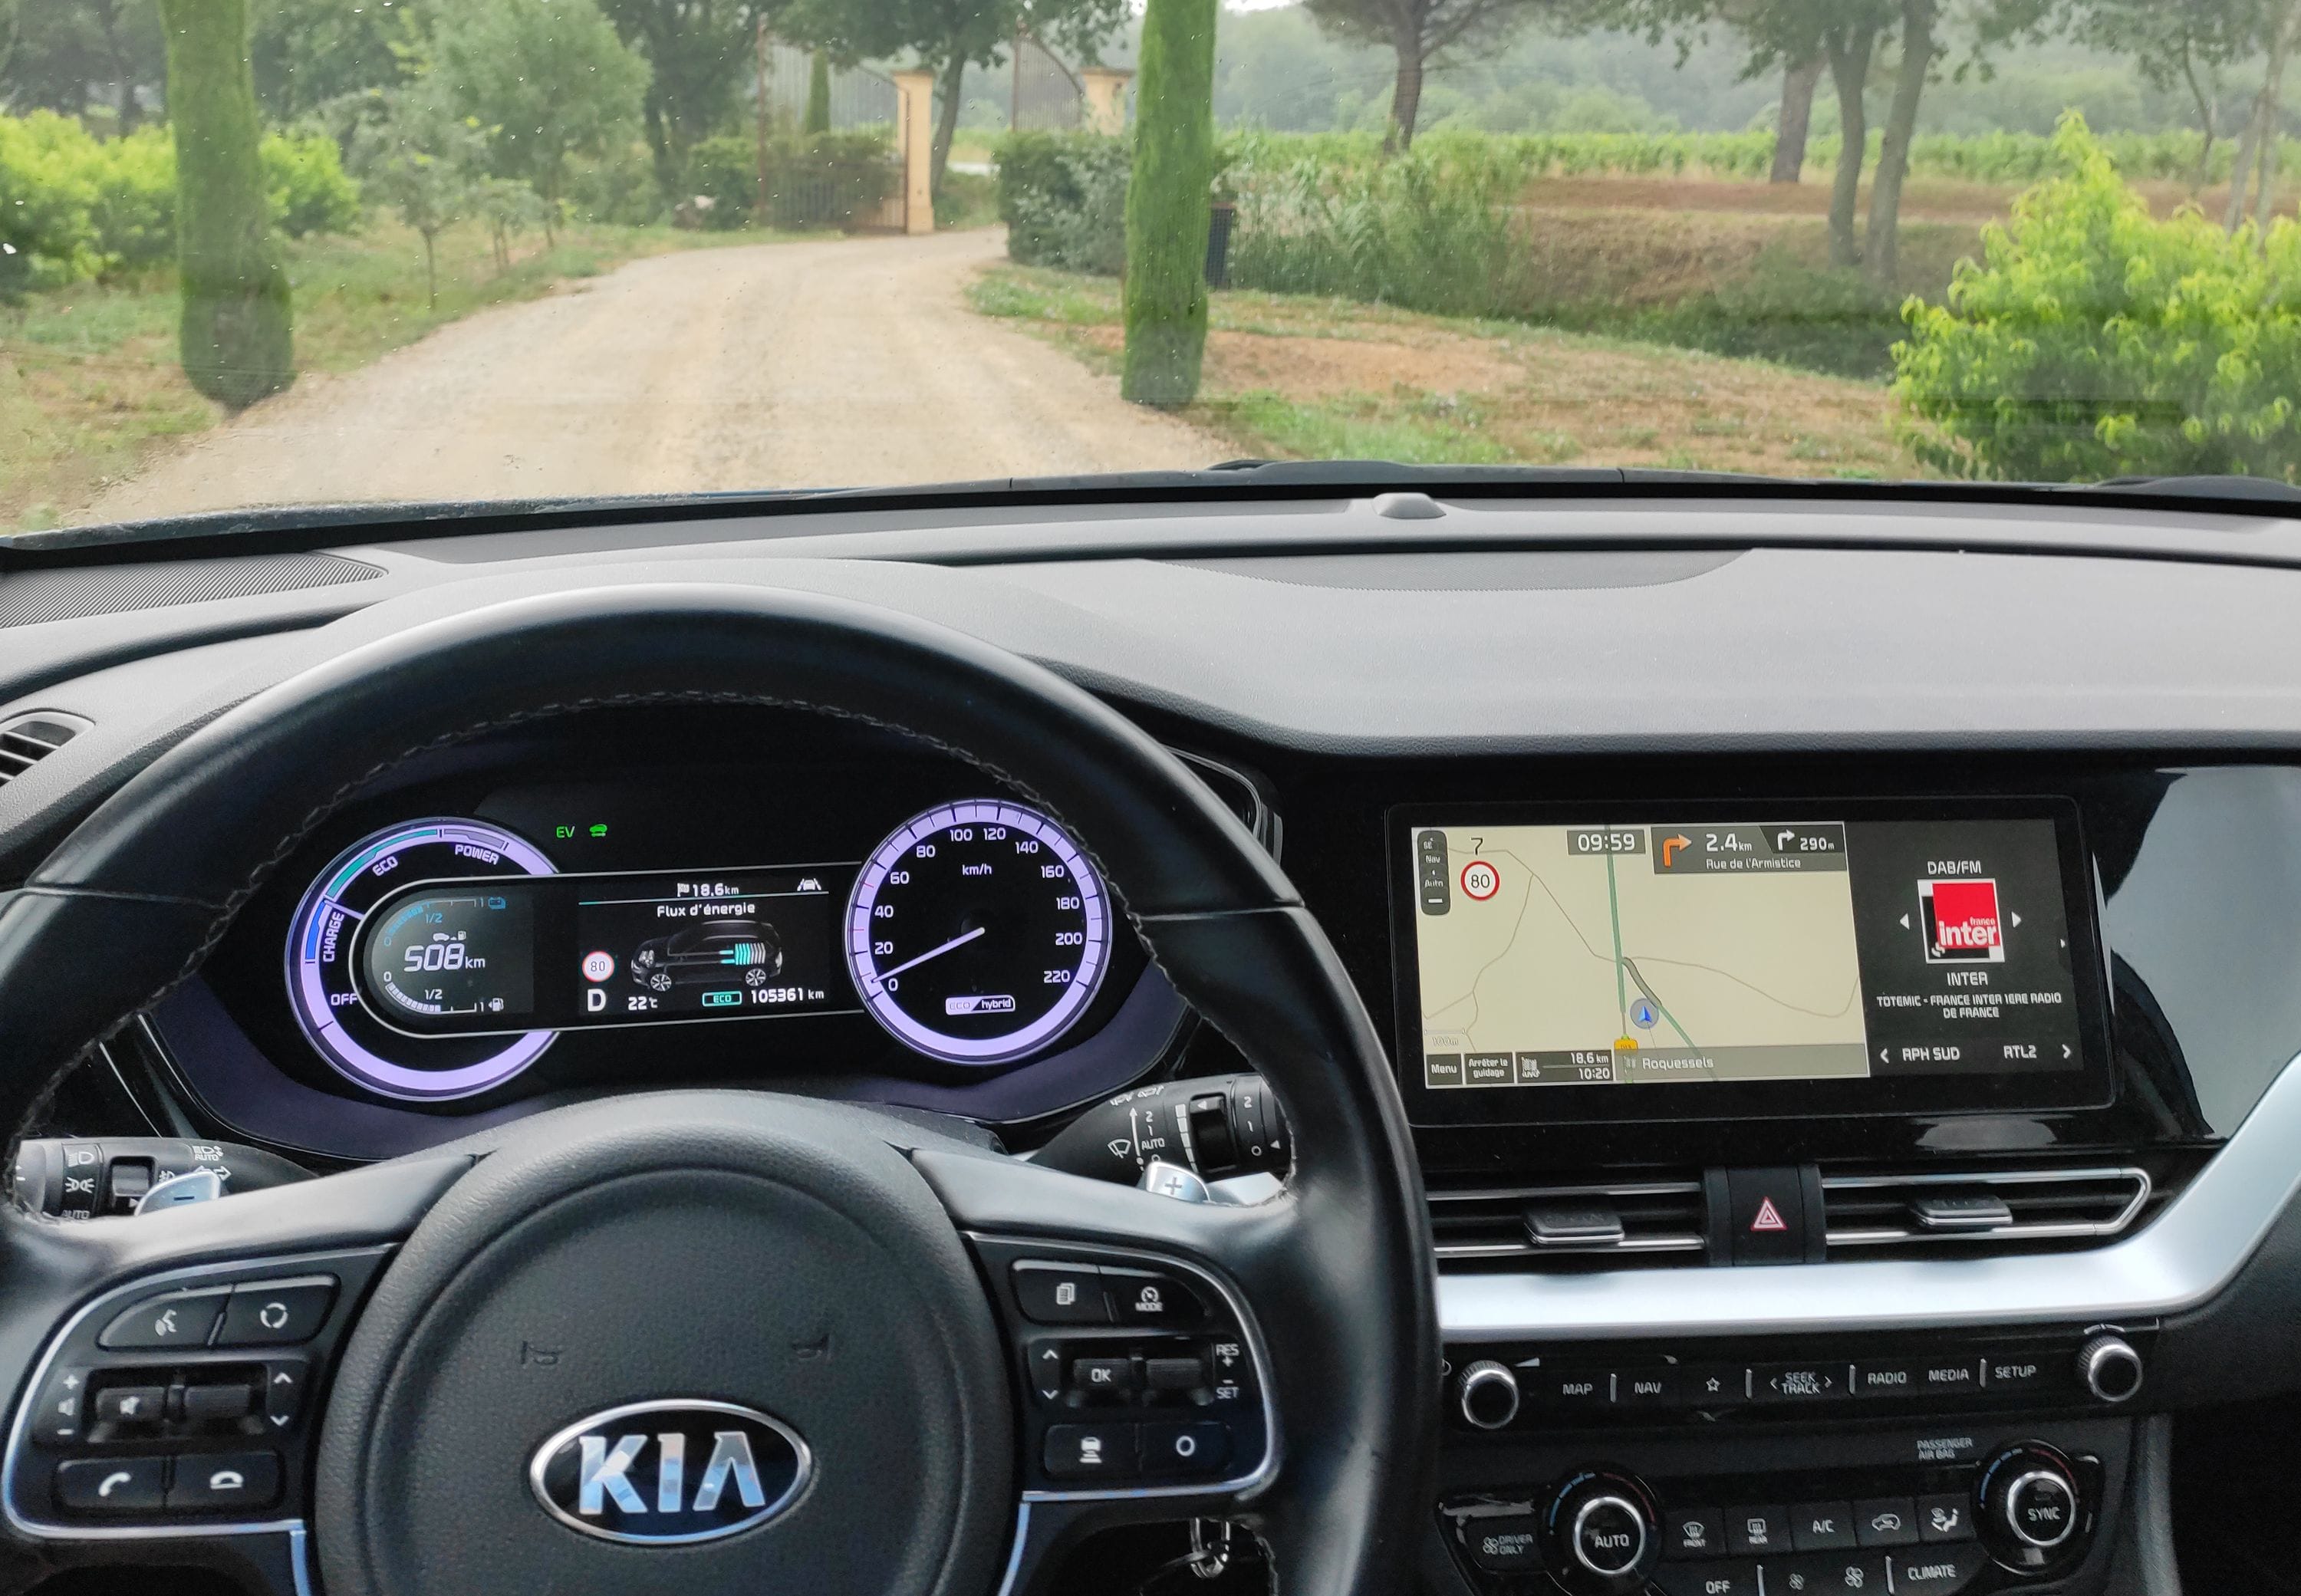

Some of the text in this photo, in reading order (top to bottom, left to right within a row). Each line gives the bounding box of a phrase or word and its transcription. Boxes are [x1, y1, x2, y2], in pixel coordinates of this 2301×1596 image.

[556, 826, 575, 837] EV
[950, 829, 973, 841] 100
[983, 828, 1006, 841] 120
[1015, 841, 1039, 854] 140
[1577, 833, 1636, 852] 09:59
[455, 844, 499, 864] POWER
[916, 845, 936, 858] 80
[372, 856, 399, 877] ECO
[962, 864, 992, 876] km/h
[1706, 859, 1727, 870] Rue
[1730, 858, 1743, 869] de
[1927, 860, 1982, 875] DAB/FM
[890, 871, 910, 884] 60
[1041, 865, 1064, 878] 160
[1470, 874, 1490, 889] 80
[1056, 897, 1080, 910] 180
[657, 904, 686, 917] Flux
[874, 905, 894, 918] 40
[426, 913, 443, 923] 1/2
[323, 911, 344, 963] CHARGE
[1055, 933, 1082, 946] 200
[1937, 921, 1998, 946] inter
[874, 942, 894, 955] 20
[591, 961, 606, 972] 80
[1043, 970, 1071, 983] 220
[1947, 972, 1988, 986] INTER
[888, 978, 898, 992] 0
[331, 993, 357, 1006] OFF
[425, 989, 443, 1000] 1/2
[587, 989, 607, 1012] D
[713, 994, 732, 1003] ECO
[751, 987, 825, 1004] 105361 km
[1877, 995, 1922, 1008] TOTEMIC
[1931, 994, 1970, 1006] FRANCE
[1973, 994, 2003, 1005] INTER
[2030, 992, 2062, 1004] RADIO
[982, 999, 1011, 1010] hybrid
[1944, 1007, 2000, 1018] DE FRANCE
[1902, 1046, 1960, 1061] RPH SUD
[2003, 1045, 2037, 1059] RTL2
[1469, 1058, 1509, 1068] Arrêter le
[1596, 1054, 1608, 1064] km
[1642, 1056, 1714, 1071] Roquessels
[1431, 1064, 1457, 1074] Menu
[1473, 1068, 1505, 1078] guidage
[1578, 1067, 1610, 1080] 10:20
[1244, 1097, 1253, 1109] 2
[1146, 1111, 1153, 1123] 2
[1141, 1138, 1165, 1150] AUTO
[1216, 1344, 1239, 1356] RES
[1091, 1369, 1111, 1382] OK
[1785, 1371, 1816, 1382] SEEK
[1868, 1371, 1907, 1385] RADIO
[1928, 1367, 1969, 1382] MEDIA
[1995, 1364, 2037, 1379] SETUP
[1216, 1387, 1239, 1399] SET
[1562, 1384, 1594, 1396] MAP
[1634, 1382, 1662, 1394] NAV
[1781, 1381, 1821, 1395] TRACK
[579, 1431, 765, 1515] KIA
[2027, 1506, 2061, 1522] SYNC
[1812, 1519, 1835, 1533] A/C
[1595, 1534, 1630, 1548] AUTO
[1908, 1563, 1957, 1581] CLIMATE
[1706, 1580, 1730, 1594] OFF
